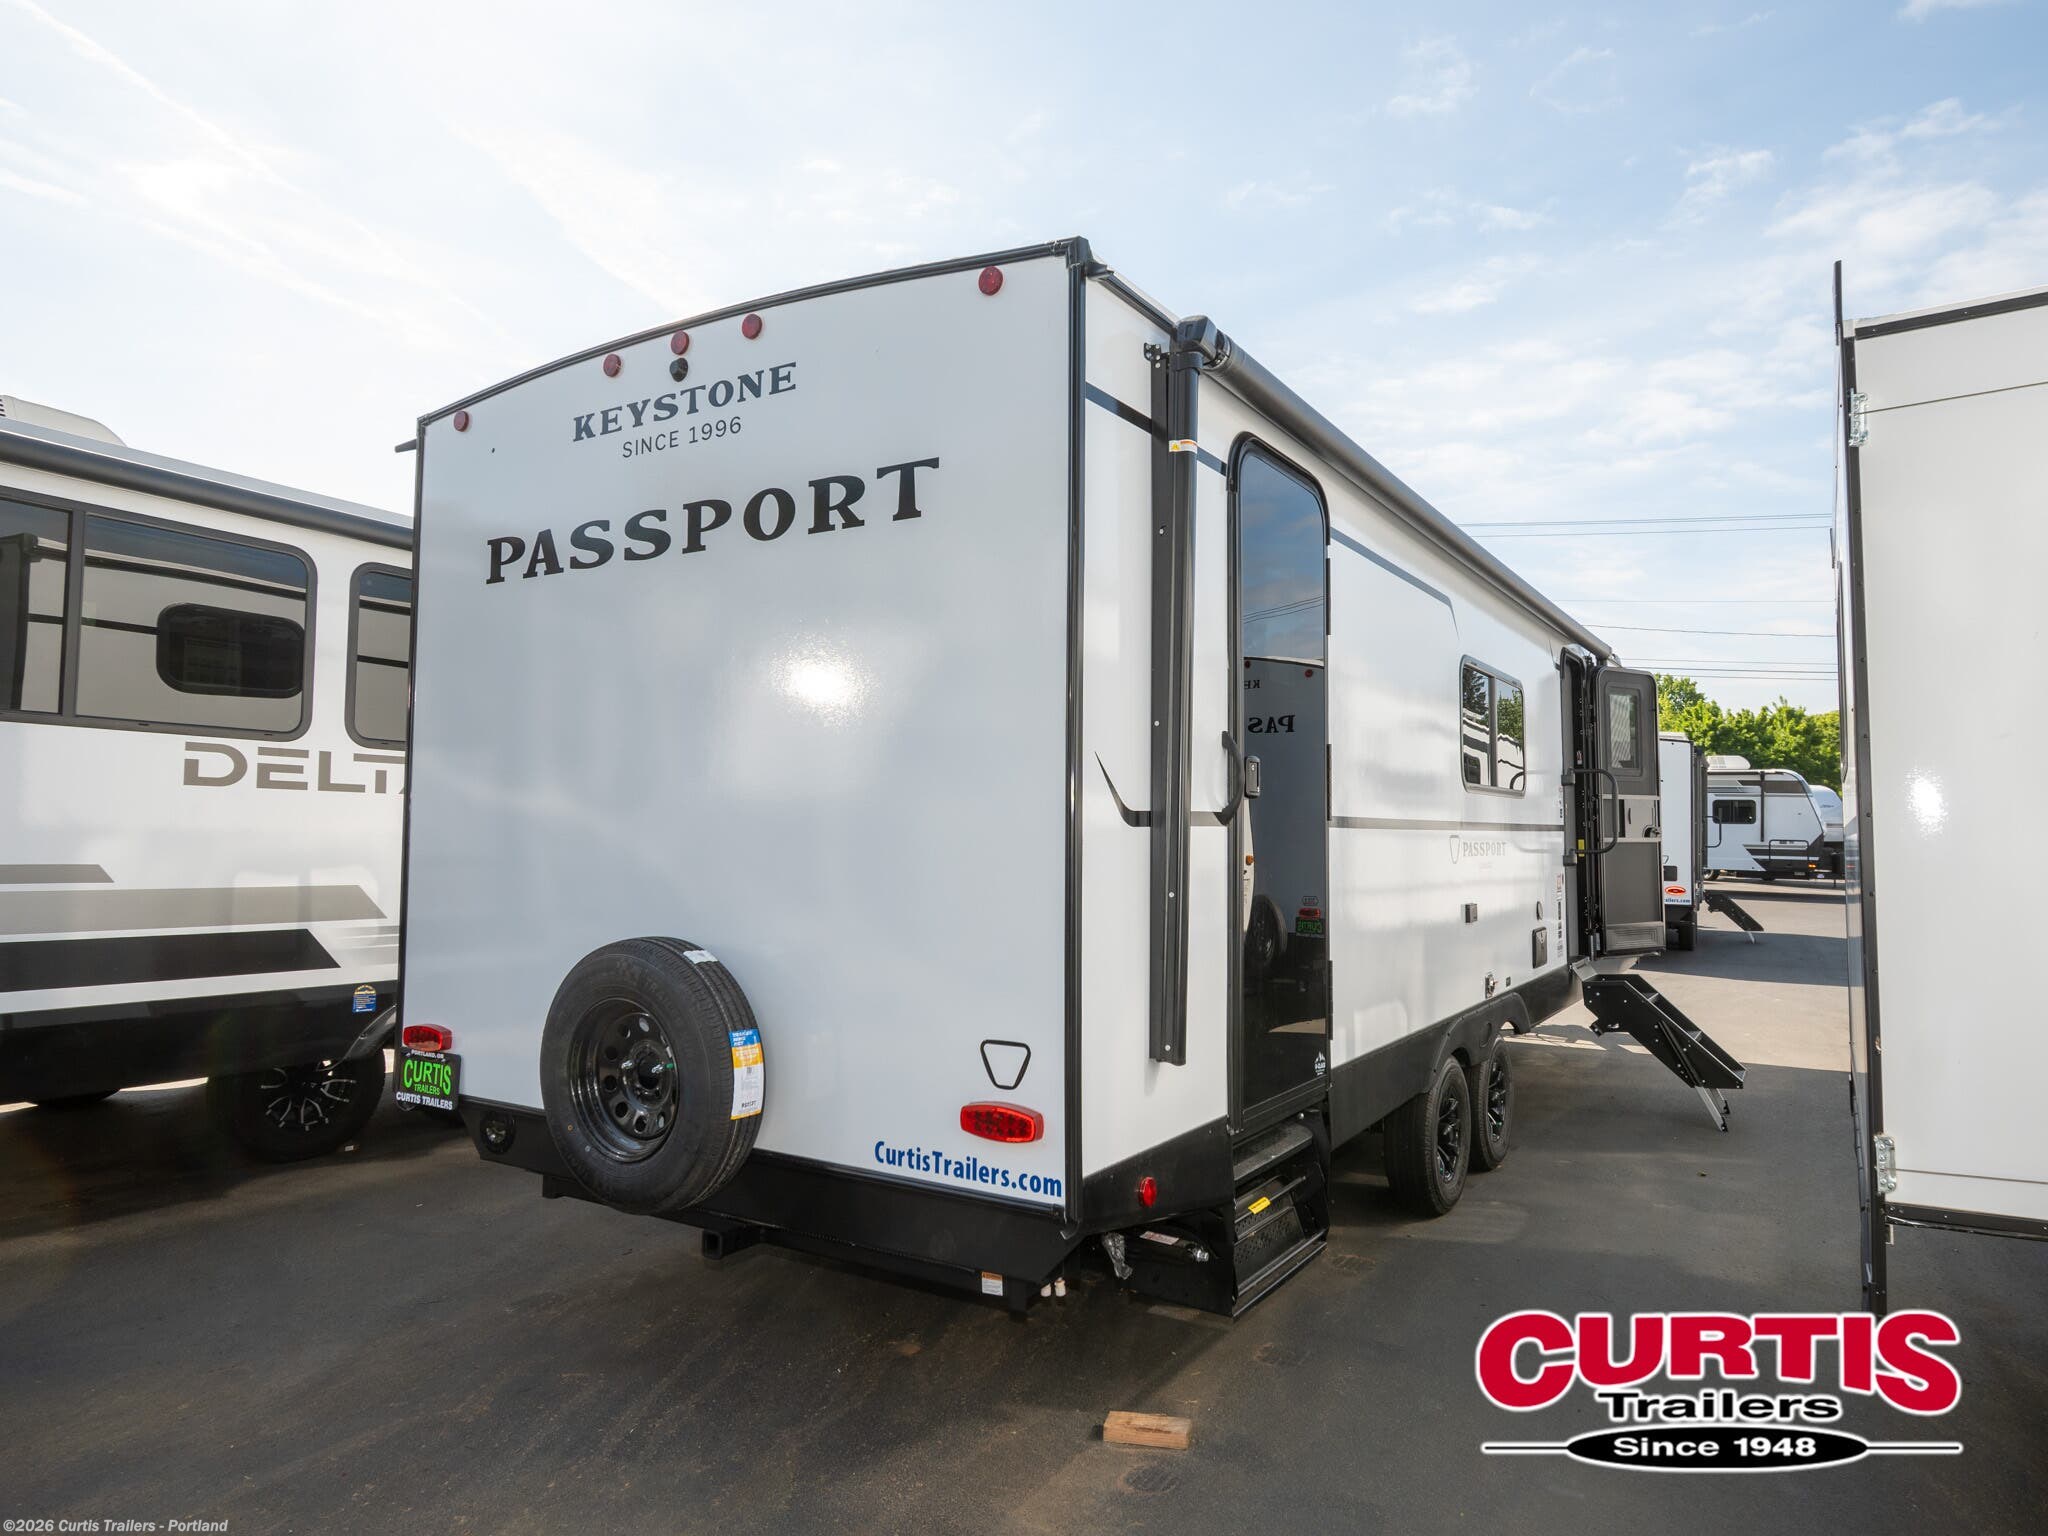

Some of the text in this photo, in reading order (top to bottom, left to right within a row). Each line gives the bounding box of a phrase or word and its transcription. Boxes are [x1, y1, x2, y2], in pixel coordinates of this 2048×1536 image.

[572, 361, 797, 442] KEYSTONE
[622, 416, 742, 458] SINCE 1996
[486, 457, 940, 584] PASSPORT
[183, 741, 406, 795] DELT
[1462, 841, 1507, 857] PASSPORT
[404, 1059, 451, 1095] CURTIS
[414, 1084, 440, 1095] TRAILERS
[396, 1092, 452, 1110] CURTIS TRAILERS
[874, 1140, 1063, 1198] CurtisTrailers.com
